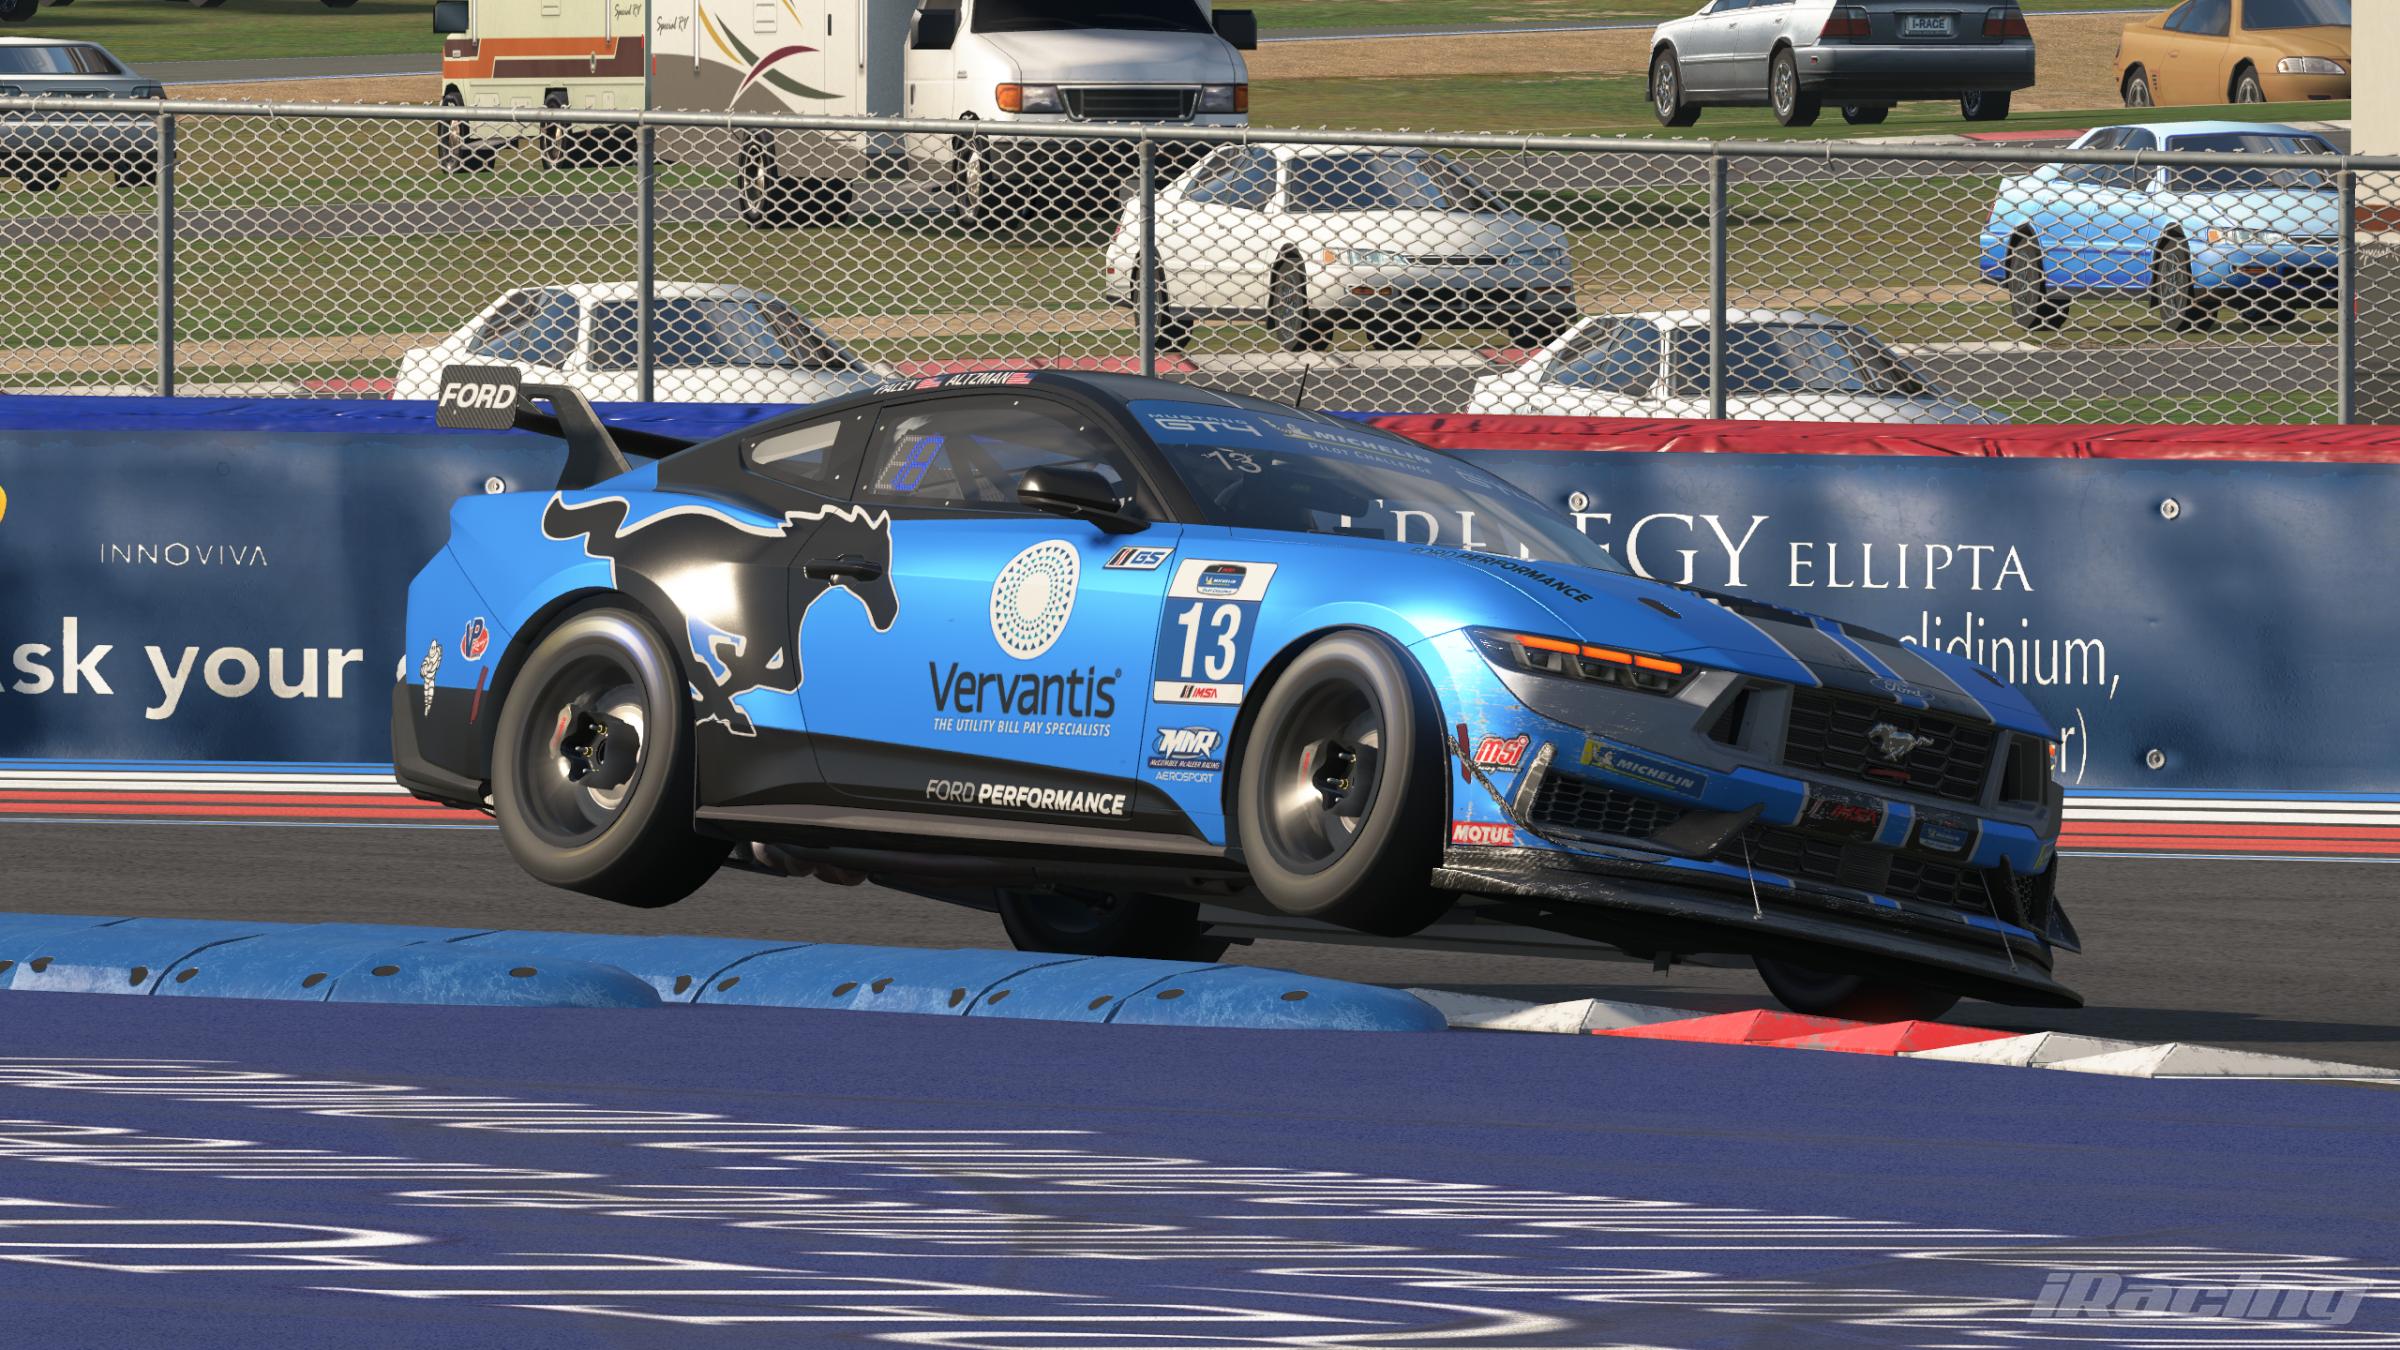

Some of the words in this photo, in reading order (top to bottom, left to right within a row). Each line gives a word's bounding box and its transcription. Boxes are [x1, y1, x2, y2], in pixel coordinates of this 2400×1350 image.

[1911, 18, 1946, 29] I-RACE
[439, 382, 517, 409] FORD
[873, 379, 922, 396] PALEY
[945, 371, 1013, 387] ALTZMAN
[1148, 413, 1248, 425] MUSTANG
[1154, 417, 1263, 438] GT4
[1308, 441, 1351, 457] PILOT
[1313, 430, 1432, 465] MICHELIN
[100, 542, 268, 567] INNOVIVA
[1130, 551, 1166, 565] GS
[1788, 542, 2035, 592] ELLIPTA
[1456, 551, 1594, 604] PERFORMANCE
[1178, 602, 1242, 681] 13
[1900, 610, 2120, 699] lidinium,
[0, 616, 114, 695] sk
[144, 645, 364, 720] your
[1191, 687, 1218, 699] IMSA
[934, 717, 953, 731] THE
[956, 718, 996, 733] UTILITY
[997, 719, 1020, 734] BILL
[1023, 721, 1044, 735] PAY
[1045, 722, 1112, 737] SPECIALISTS
[1158, 728, 1218, 759] MMR
[1474, 733, 1531, 767] msi
[1155, 771, 1215, 783] AEROSPORT
[1615, 757, 1695, 789] MICHELIN
[926, 779, 976, 803] FORD
[977, 783, 1127, 816] PERFORMANCE
[1452, 823, 1514, 843] MOTUL
